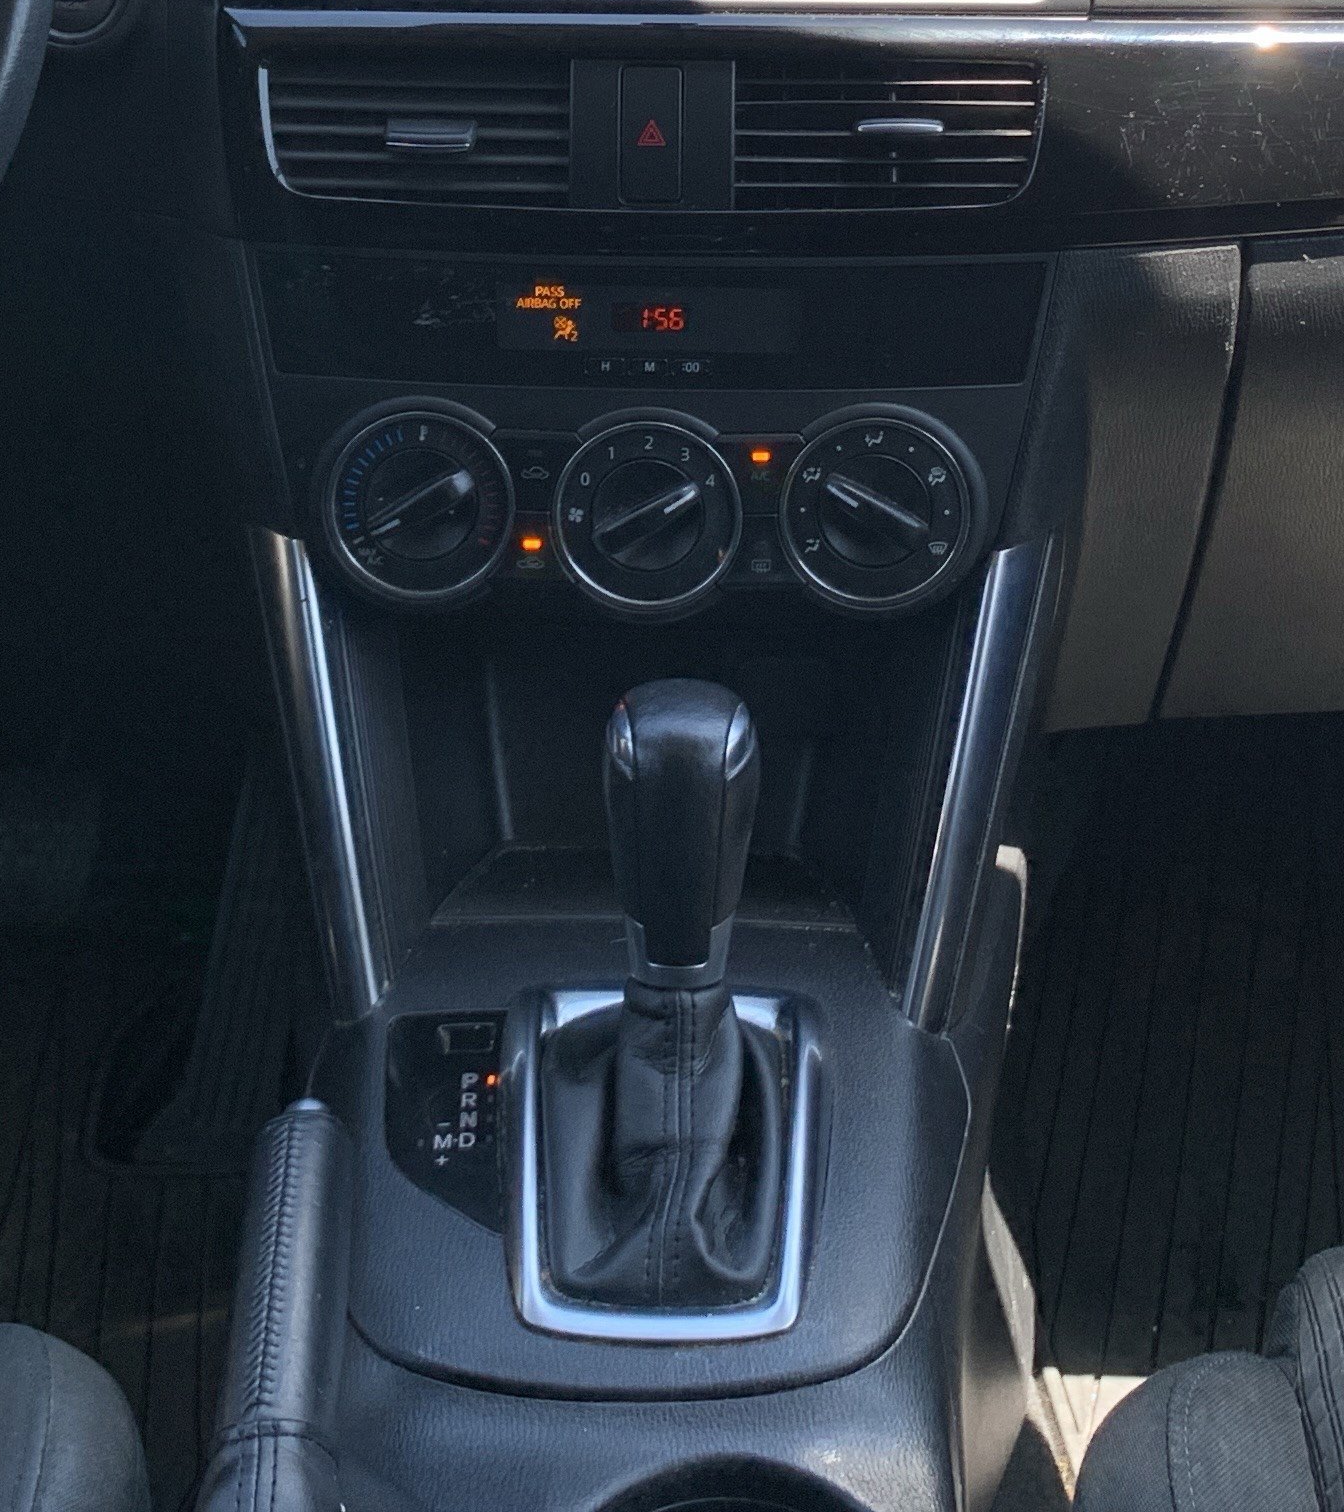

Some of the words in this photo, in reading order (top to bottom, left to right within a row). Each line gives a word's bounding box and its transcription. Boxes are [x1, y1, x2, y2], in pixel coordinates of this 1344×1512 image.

[535, 286, 565, 297] PASS
[516, 298, 556, 309] AIRBAG
[560, 298, 582, 309] OFF
[601, 361, 610, 372] H
[645, 361, 655, 372] M
[644, 436, 654, 450] 2
[608, 446, 615, 460] 1
[680, 447, 690, 461] 3
[580, 472, 590, 486] 0
[705, 474, 715, 487] 4
[461, 1072, 479, 1088] P
[460, 1092, 478, 1107] R
[460, 1111, 478, 1128] N
